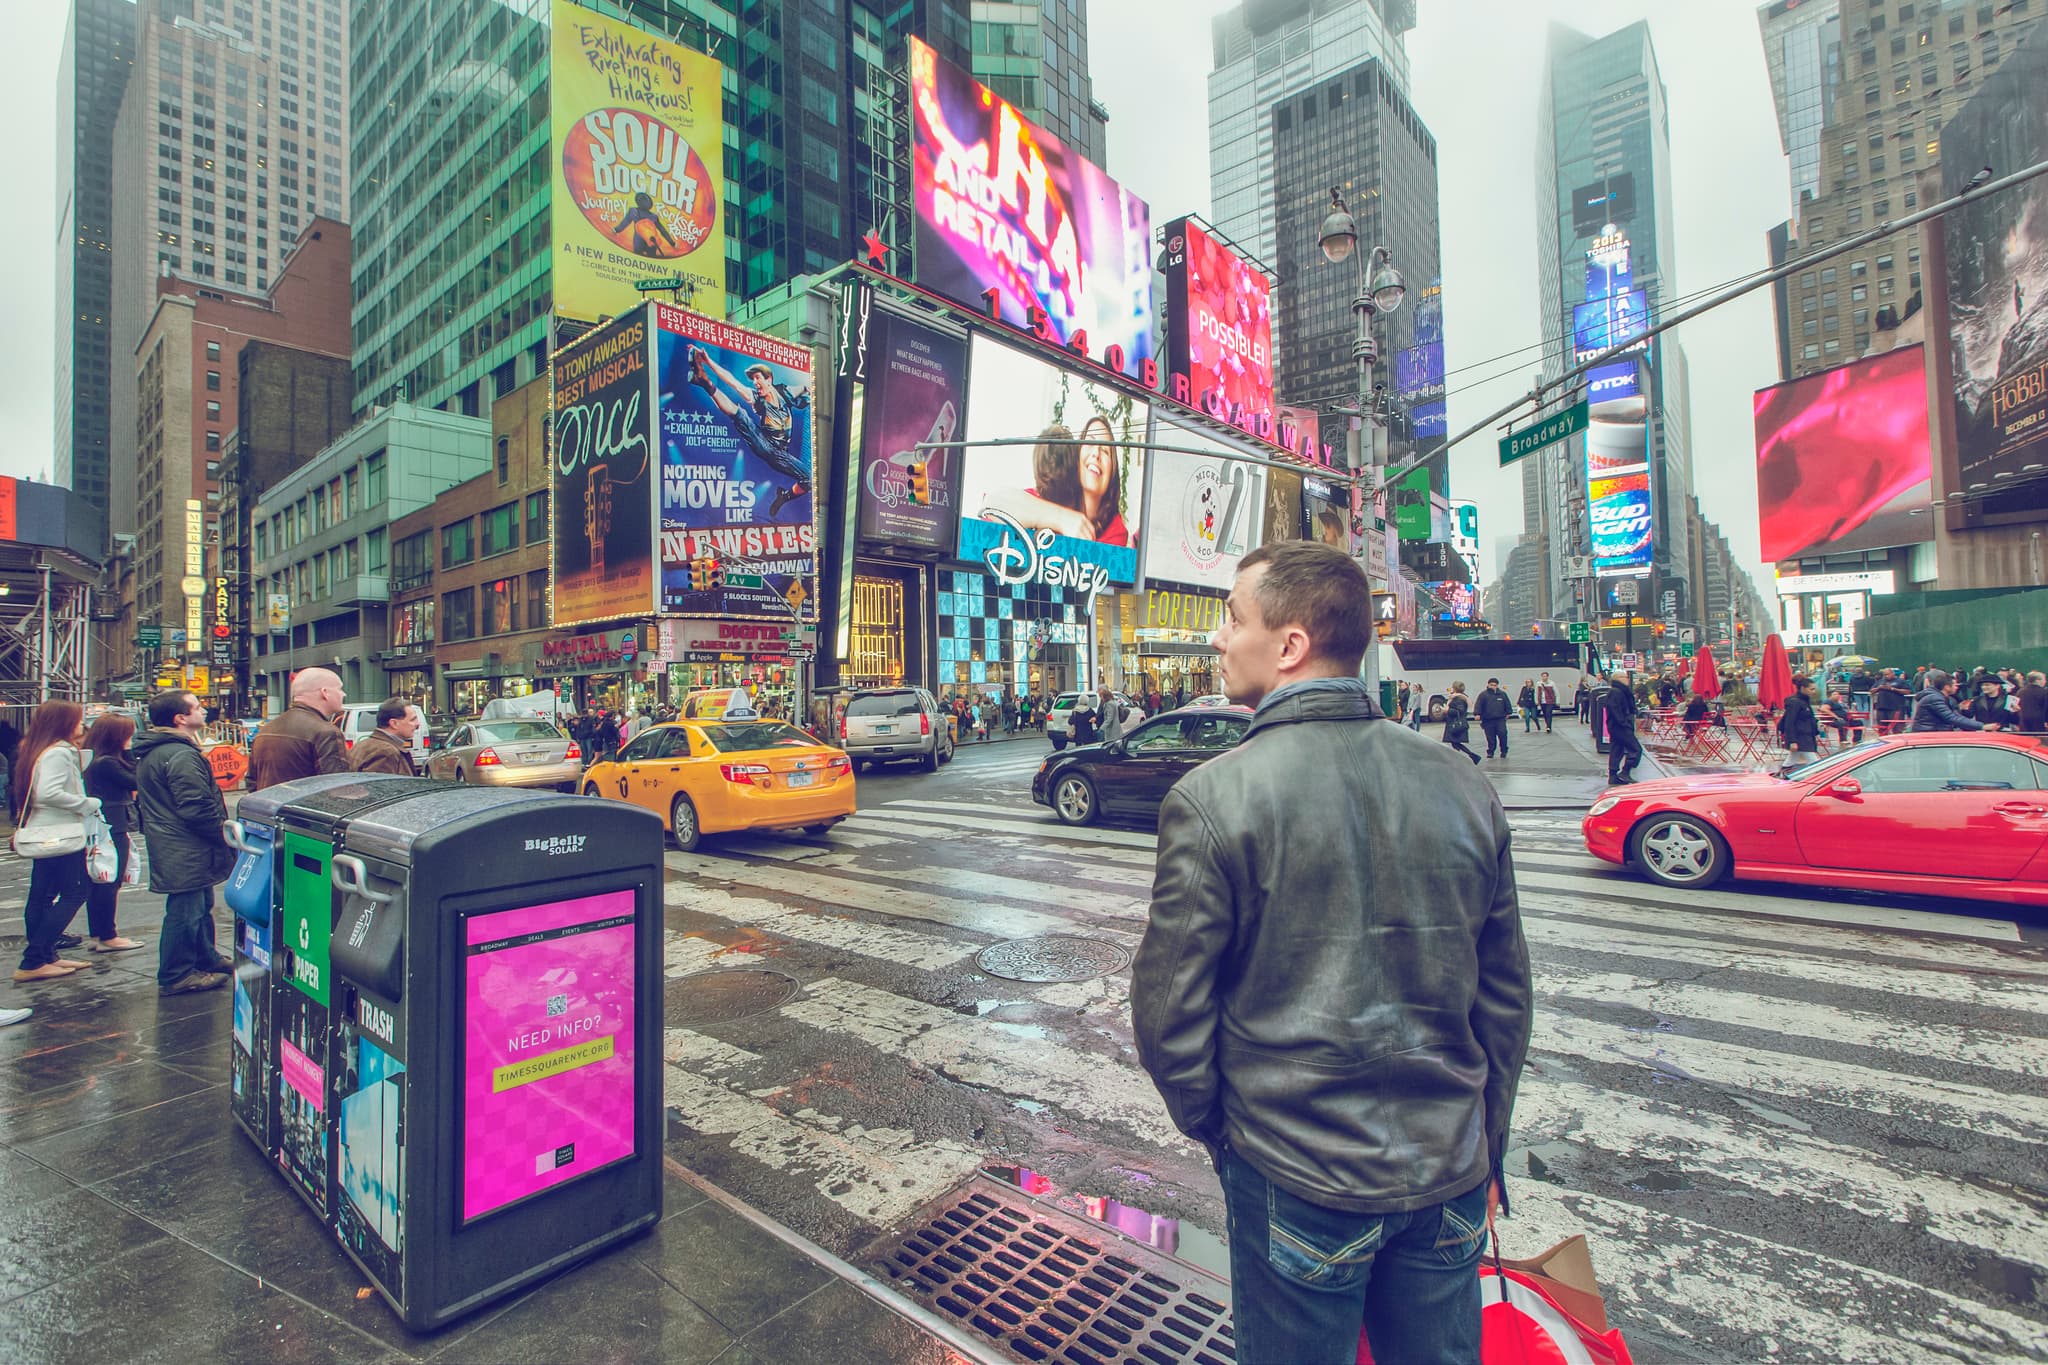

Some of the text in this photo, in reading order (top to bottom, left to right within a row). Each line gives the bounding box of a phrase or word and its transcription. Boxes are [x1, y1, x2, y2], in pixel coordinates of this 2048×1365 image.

[585, 109, 698, 184] SOUL
[592, 158, 697, 215] DOCTOR
[581, 189, 627, 218] Journey
[933, 187, 1038, 273] RETAIL
[1592, 232, 1623, 249] 2013
[1586, 240, 1631, 258] TOSHIBA
[563, 243, 572, 253] A
[576, 245, 604, 260] NEW
[608, 252, 669, 276] BROADWAY
[673, 269, 719, 289] MUSICAL
[590, 262, 617, 275] CIRCLE
[1169, 254, 1183, 267] LG
[638, 279, 679, 289] LAMAR
[660, 307, 809, 363] BEST SCORE BEST CHOREOGRAPHY
[667, 321, 693, 336] 2012
[698, 332, 724, 345] TONY
[728, 340, 761, 356] AWARD
[1200, 309, 1265, 367] POSSIBLE!
[564, 349, 593, 381] TONY
[593, 321, 644, 366] AWARDS
[556, 349, 645, 409] BEST MUSICAL
[1604, 374, 1635, 389] TDK
[1991, 362, 2048, 429] HOBBI
[670, 422, 728, 437] EXHILARATING
[1511, 414, 1575, 455] Broadway
[2005, 413, 2038, 436] DECEMBER
[685, 436, 701, 447] JOLT
[663, 464, 727, 480] NOTHING
[663, 479, 756, 509] MOVES
[725, 508, 753, 523] LIKE
[1590, 503, 1646, 522] BUD
[660, 524, 815, 562] NEWSIES
[1439, 542, 1447, 568] 1500
[216, 577, 229, 618] PARK
[729, 592, 751, 601] BLOCKS
[752, 594, 771, 602] SOUTH
[1147, 588, 1223, 631] FOREVER
[696, 653, 713, 661] Apple
[720, 652, 745, 662] Nikon
[751, 653, 782, 662] Canon
[210, 752, 233, 763] LANE
[212, 760, 240, 773] LOSED
[524, 834, 587, 851] BigBelly
[548, 845, 578, 856] SOLAR
[527, 934, 544, 942] DEALS
[561, 927, 581, 936] EVENTS
[480, 941, 509, 951] BROADWAY
[295, 954, 320, 991] PAPER
[360, 997, 394, 1046] TRASH
[508, 1014, 602, 1053] NEED INFO?
[499, 1042, 610, 1083] TIMESSQUARENYC.ORG
